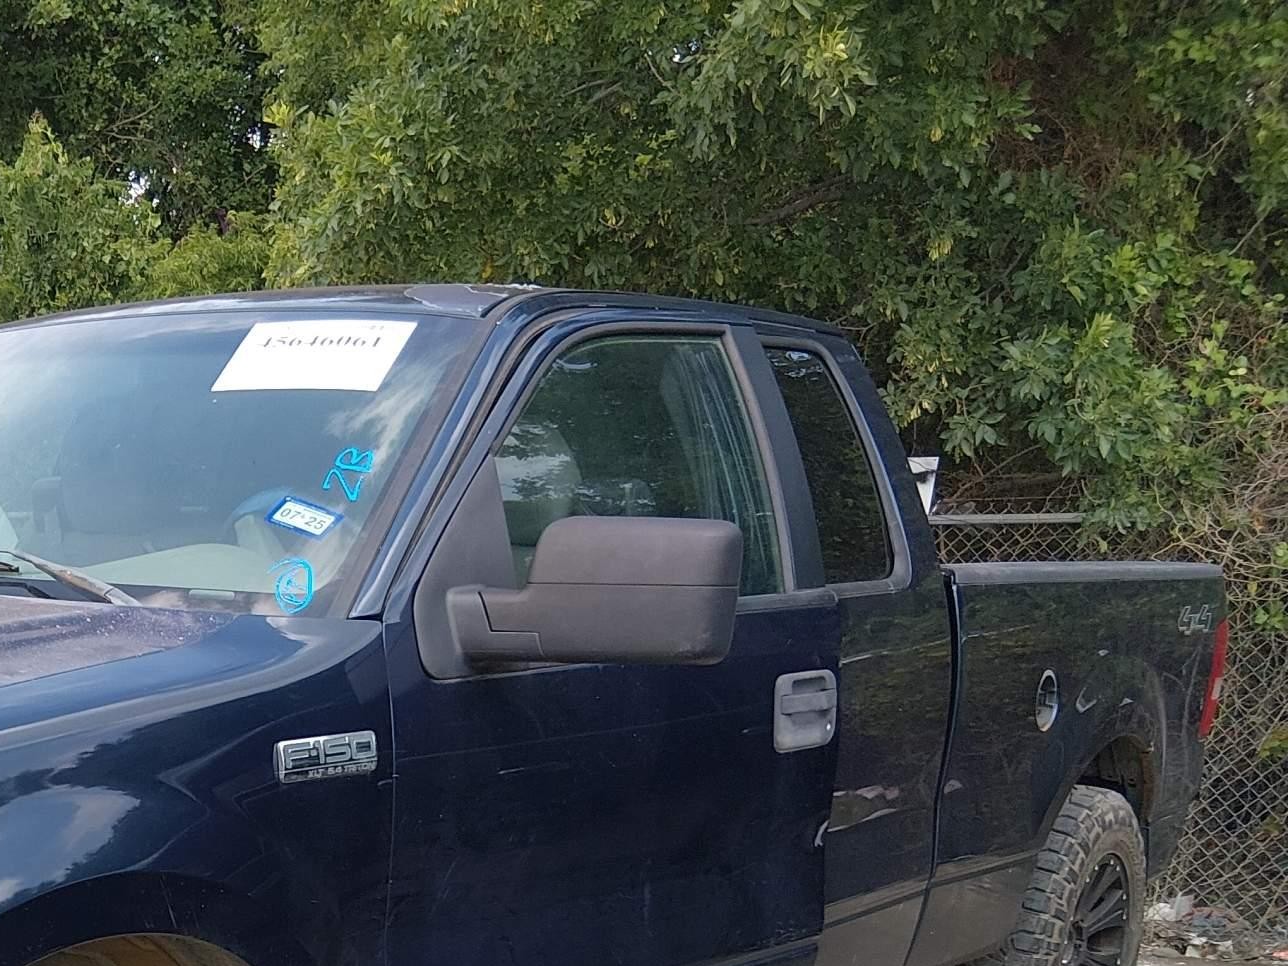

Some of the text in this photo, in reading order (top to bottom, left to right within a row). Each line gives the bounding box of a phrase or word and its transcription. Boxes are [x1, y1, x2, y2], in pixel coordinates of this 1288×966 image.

[280, 507, 301, 521] 07
[304, 515, 327, 530] 25
[283, 732, 376, 769] F-150
